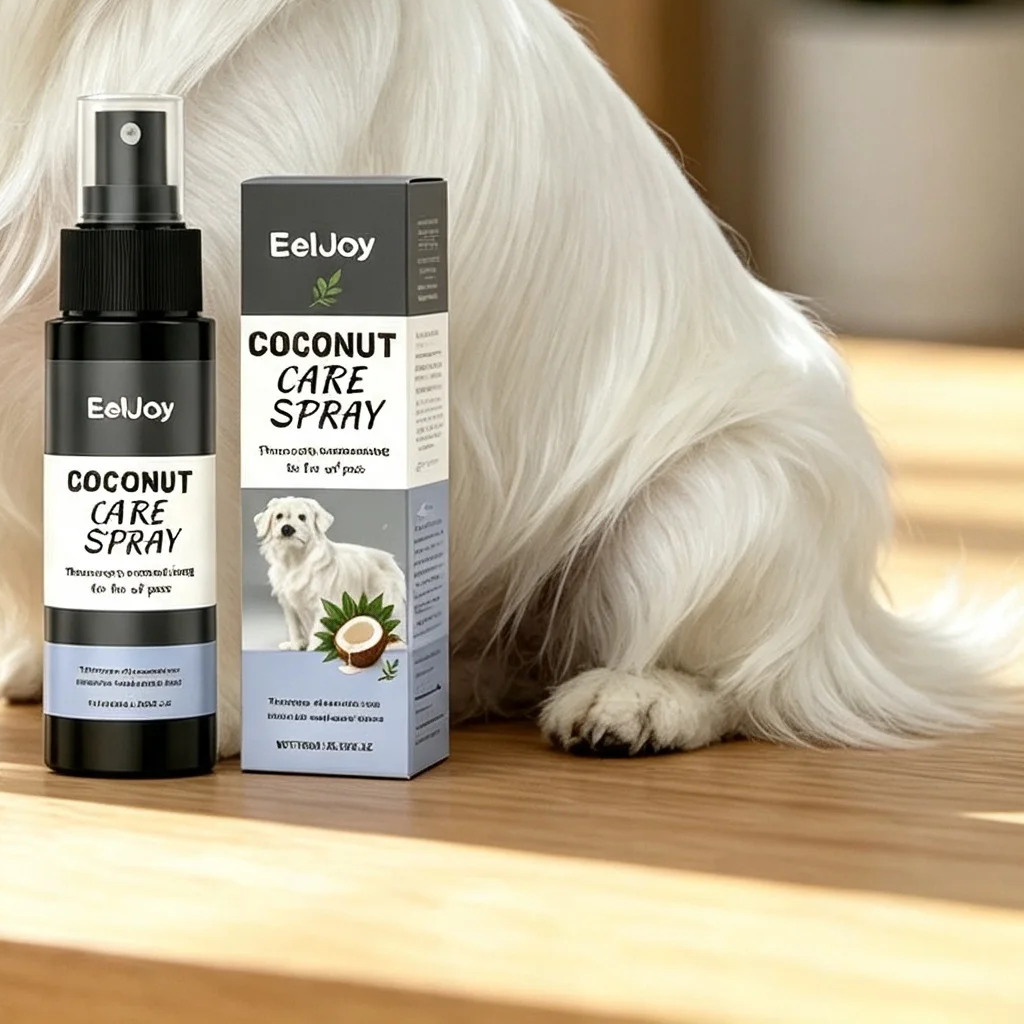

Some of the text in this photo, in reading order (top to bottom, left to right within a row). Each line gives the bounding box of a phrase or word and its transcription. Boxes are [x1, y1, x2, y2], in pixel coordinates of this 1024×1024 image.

[269, 231, 376, 262] EelJoy
[248, 331, 397, 358] COCONUT
[277, 364, 369, 395] CARE
[87, 396, 175, 423] EelJoy
[270, 398, 387, 430] SPRAY
[67, 470, 193, 494] COCONUT
[90, 499, 169, 525] CARE
[84, 528, 183, 556] SPRAY
